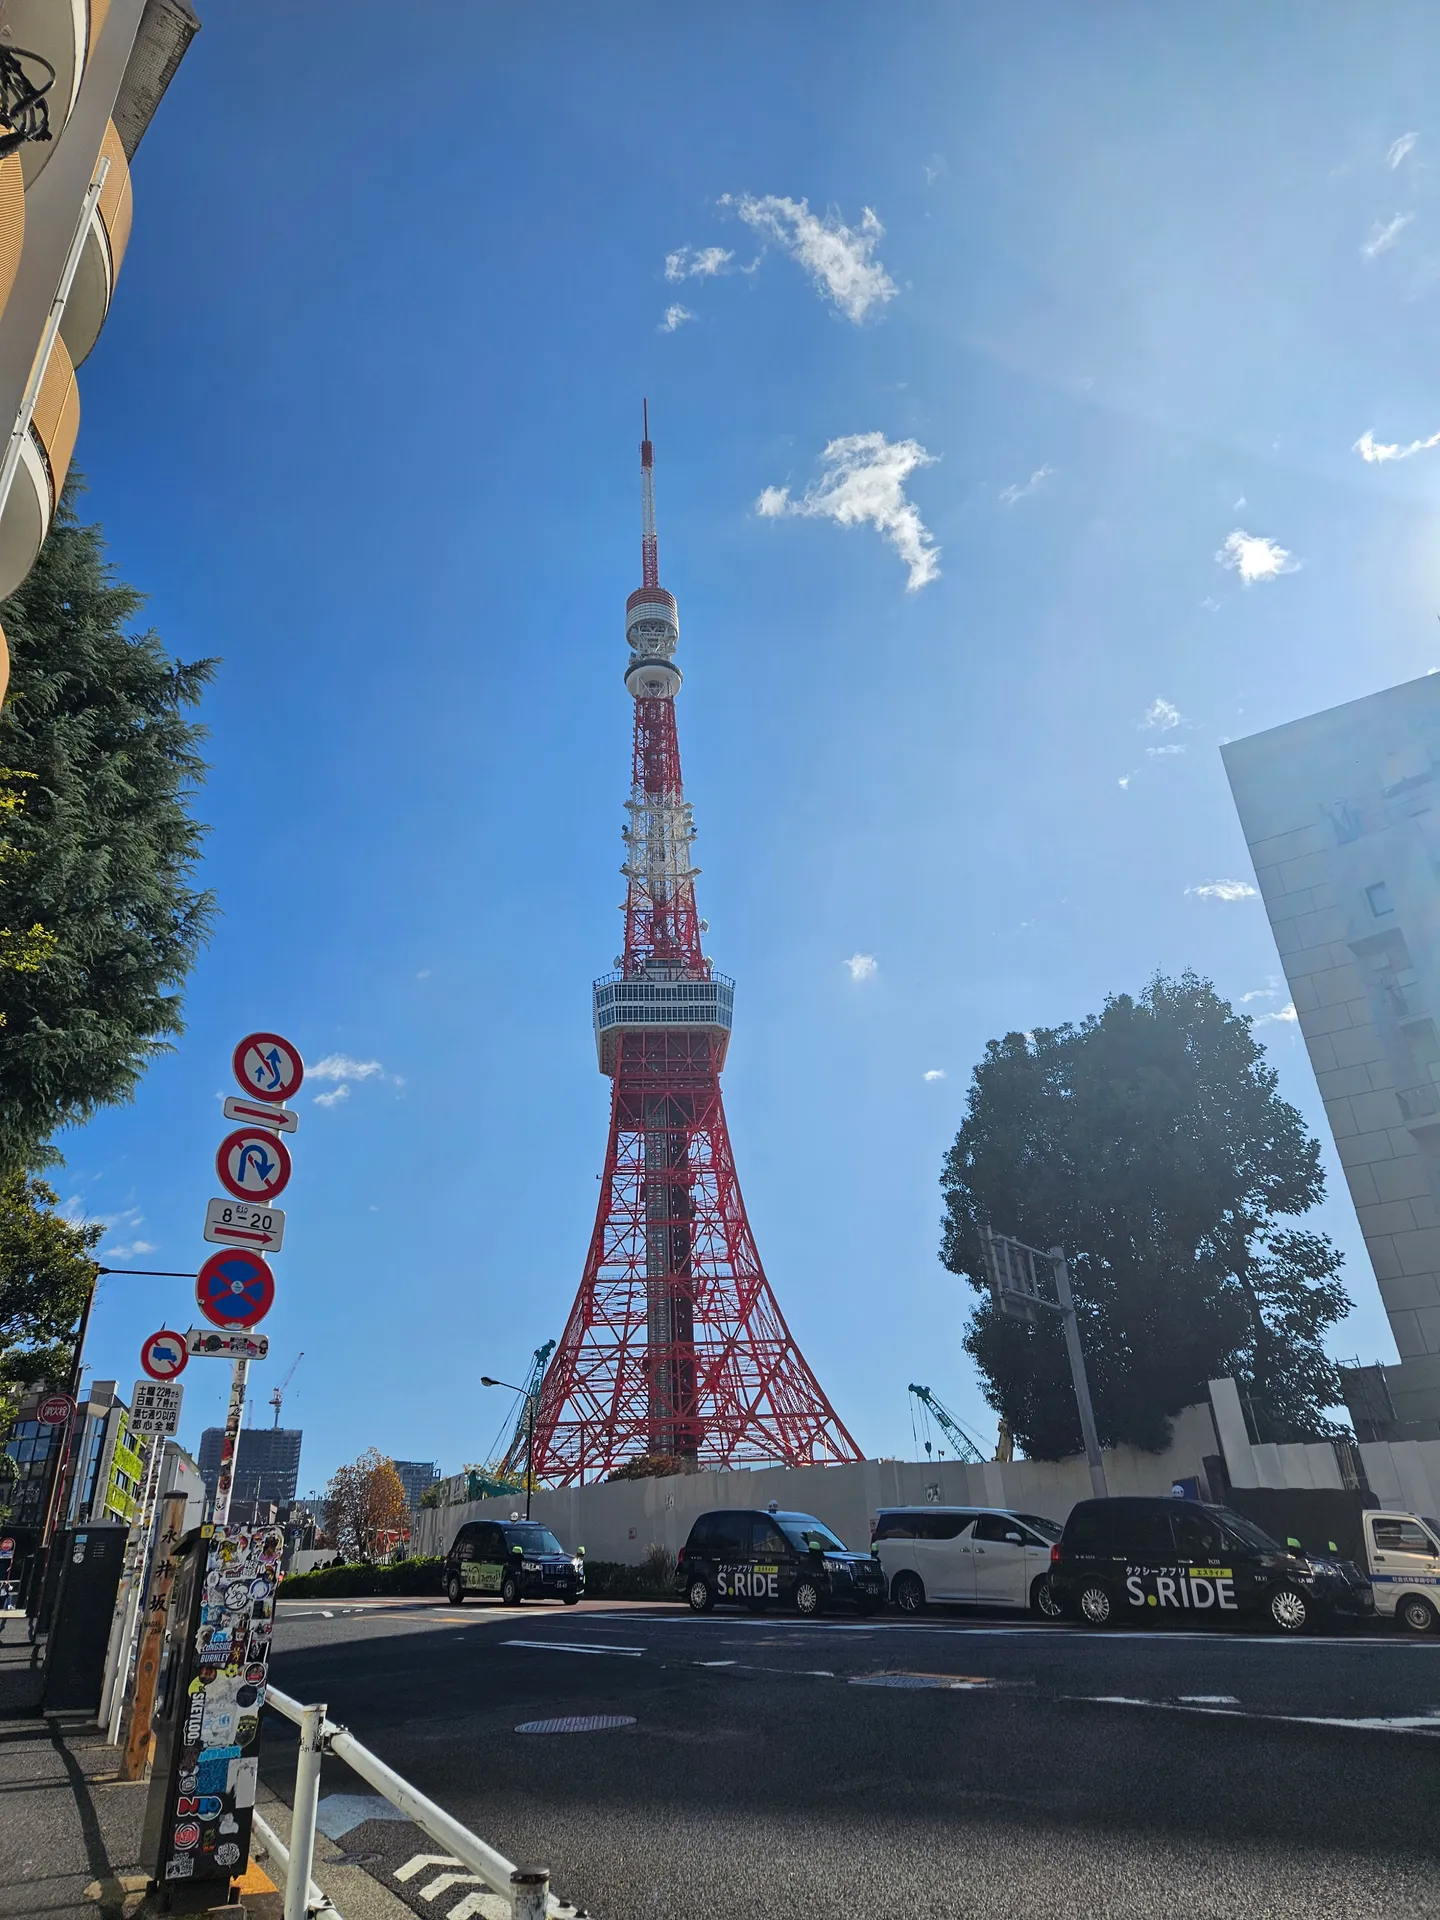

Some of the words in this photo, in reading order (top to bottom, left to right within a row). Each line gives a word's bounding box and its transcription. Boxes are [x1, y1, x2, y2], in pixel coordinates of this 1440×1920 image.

[44, 1405, 68, 1417] 消火栓
[149, 1528, 177, 1613] 永井坂
[718, 1564, 753, 1573] タクシーアプリ
[1126, 1566, 1186, 1577] タクシーアプリ
[1197, 1568, 1225, 1577] エスライド
[717, 1572, 779, 1598] S.RIDE
[1126, 1576, 1239, 1610] S.RIDE
[200, 1653, 231, 1663] BURNLEY
